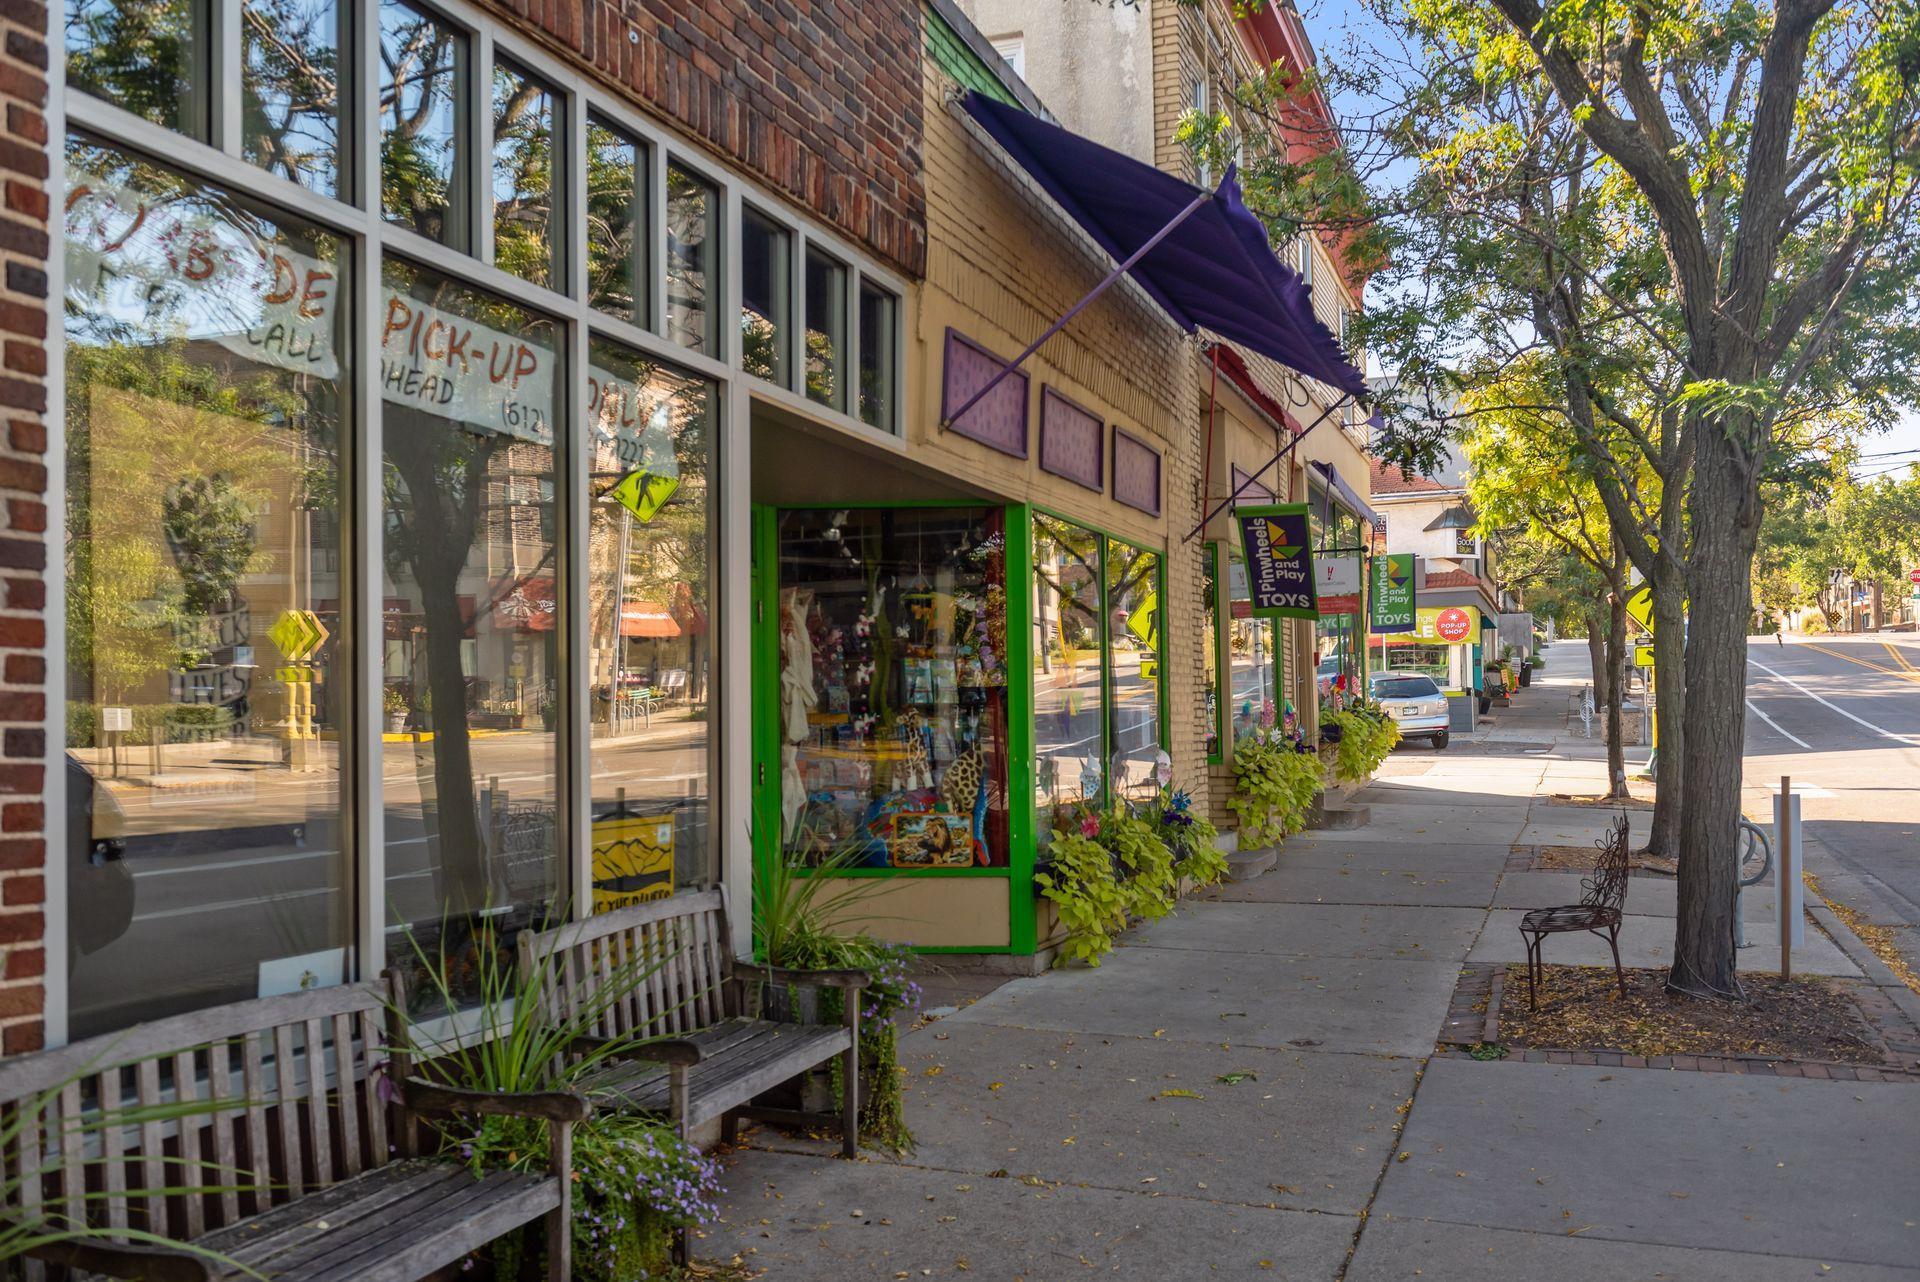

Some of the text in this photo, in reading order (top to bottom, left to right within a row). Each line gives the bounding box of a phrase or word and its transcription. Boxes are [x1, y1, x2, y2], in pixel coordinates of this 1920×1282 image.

[382, 295, 537, 390] PICK-UP
[1247, 517, 1276, 592] Pinwheels
[1275, 560, 1300, 569] and
[1275, 570, 1306, 583] Play
[1375, 555, 1388, 614] Pinwheels
[1259, 593, 1310, 608] TOYS
[1389, 596, 1410, 605] Play
[1376, 613, 1411, 625] TOYS
